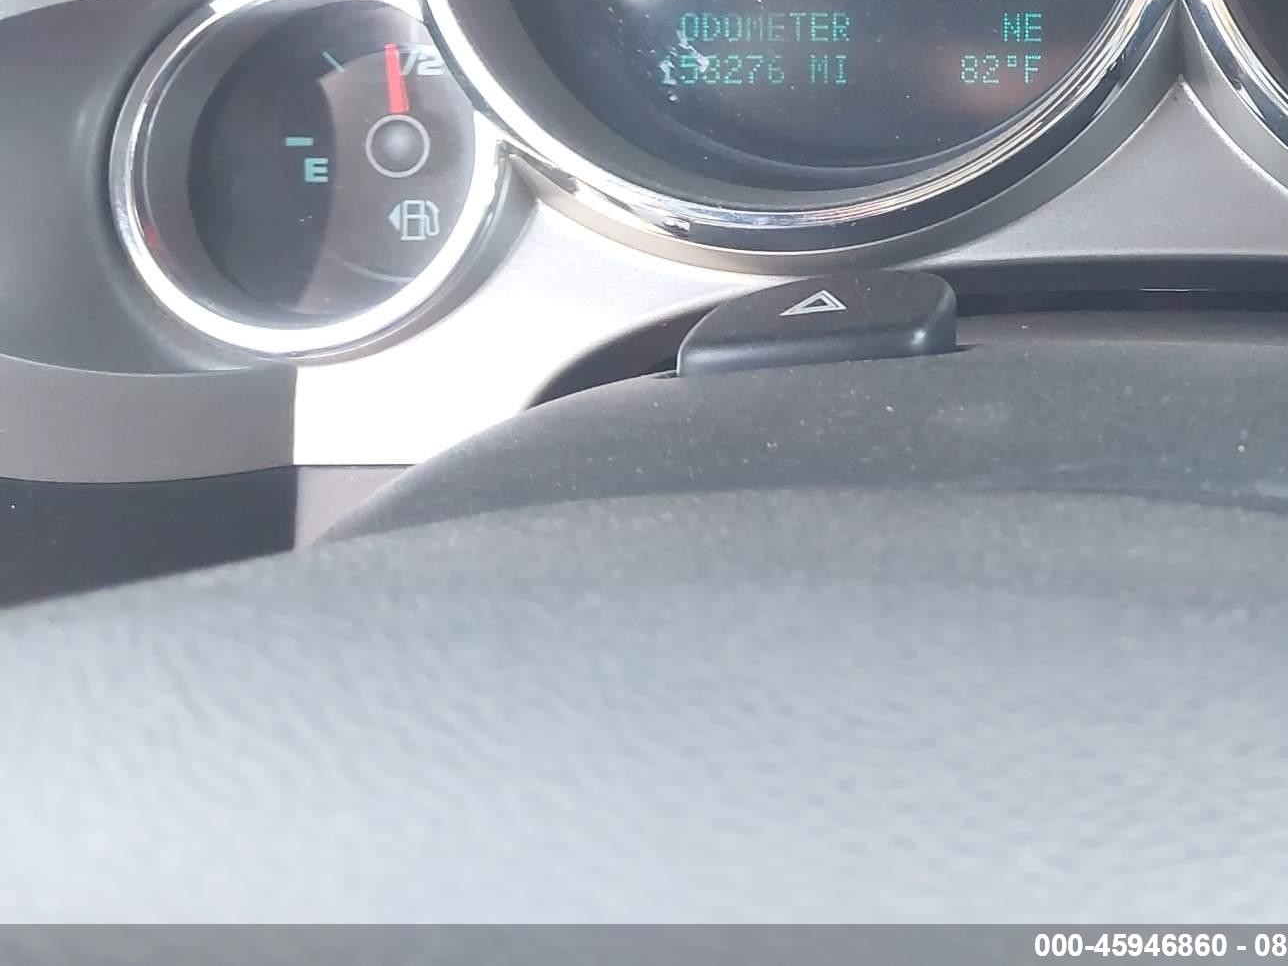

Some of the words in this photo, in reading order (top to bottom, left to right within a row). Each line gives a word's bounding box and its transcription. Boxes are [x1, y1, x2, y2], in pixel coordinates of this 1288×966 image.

[680, 12, 850, 42] ODOMETER
[1003, 12, 1042, 42] NE
[810, 54, 847, 84] MI
[961, 55, 1042, 84] 82°F
[304, 157, 329, 183] E
